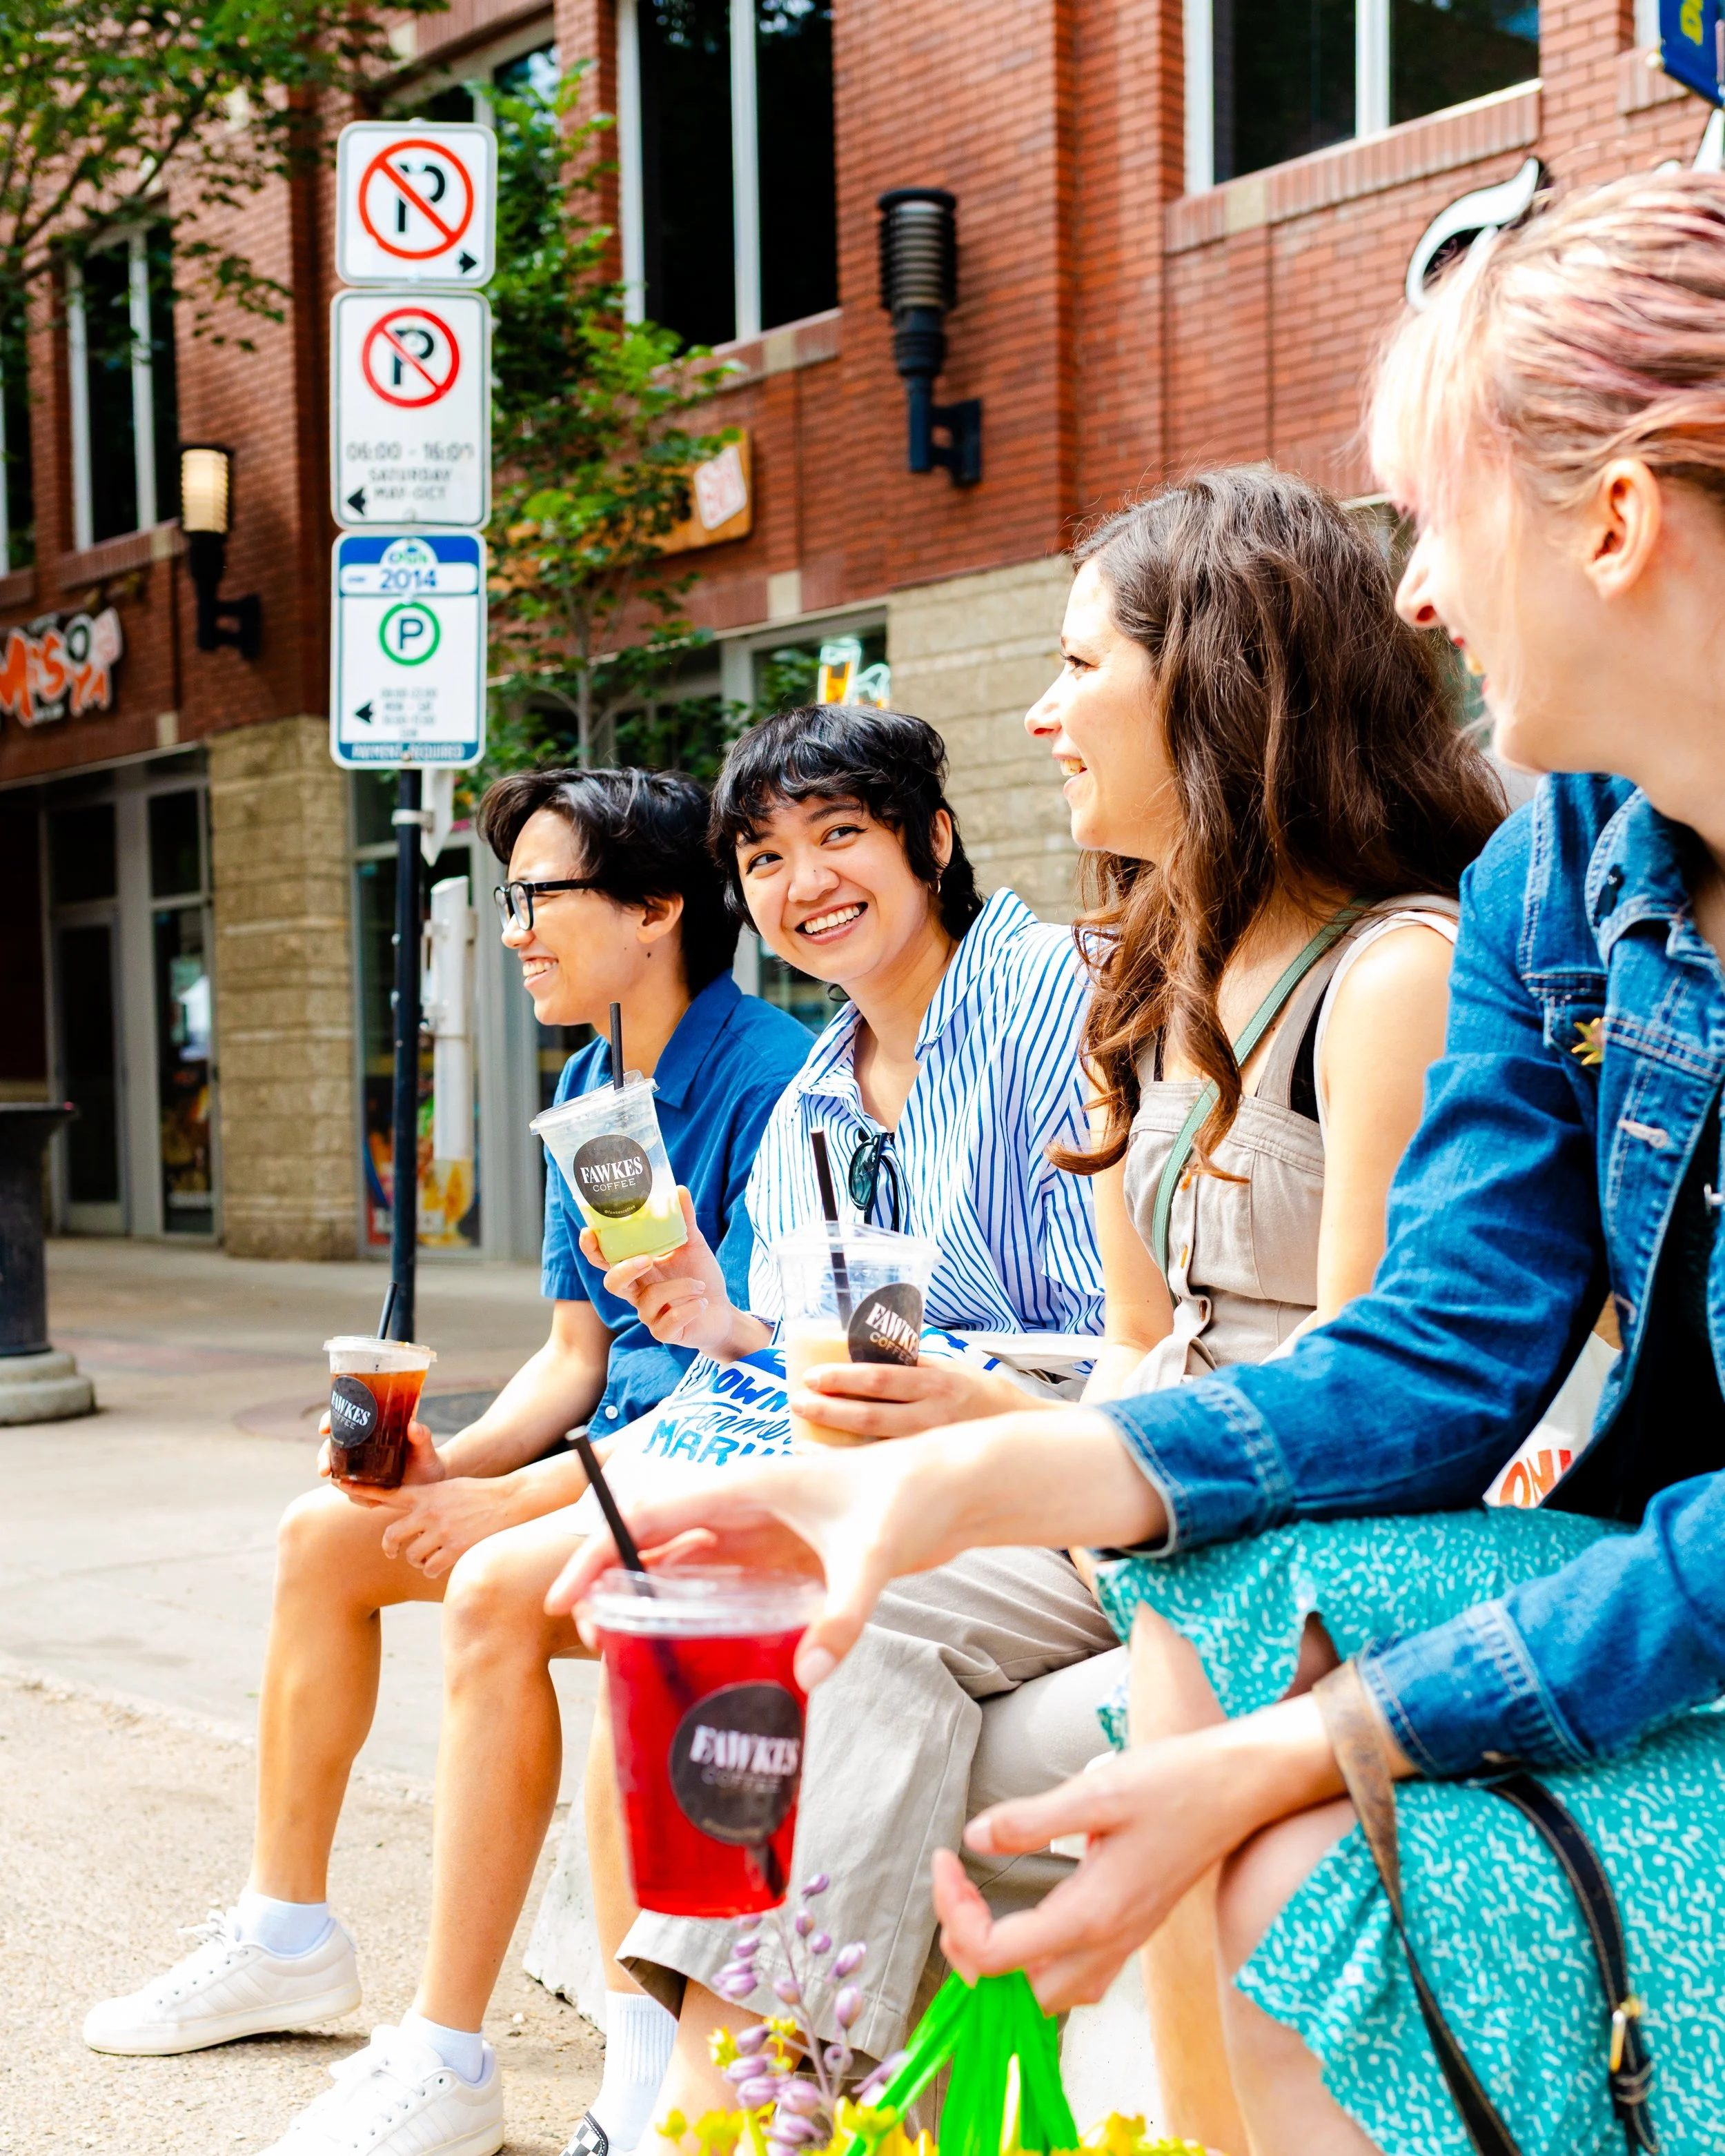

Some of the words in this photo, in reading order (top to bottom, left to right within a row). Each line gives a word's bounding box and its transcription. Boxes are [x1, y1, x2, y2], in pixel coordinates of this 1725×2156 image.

[380, 568, 437, 590] 2014
[399, 618, 424, 650] P
[580, 1156, 643, 1184] FAWKES
[593, 1178, 636, 1192] COFFEE
[331, 1390, 371, 1426] FAWKES
[689, 1725, 800, 1777] FAWKES
